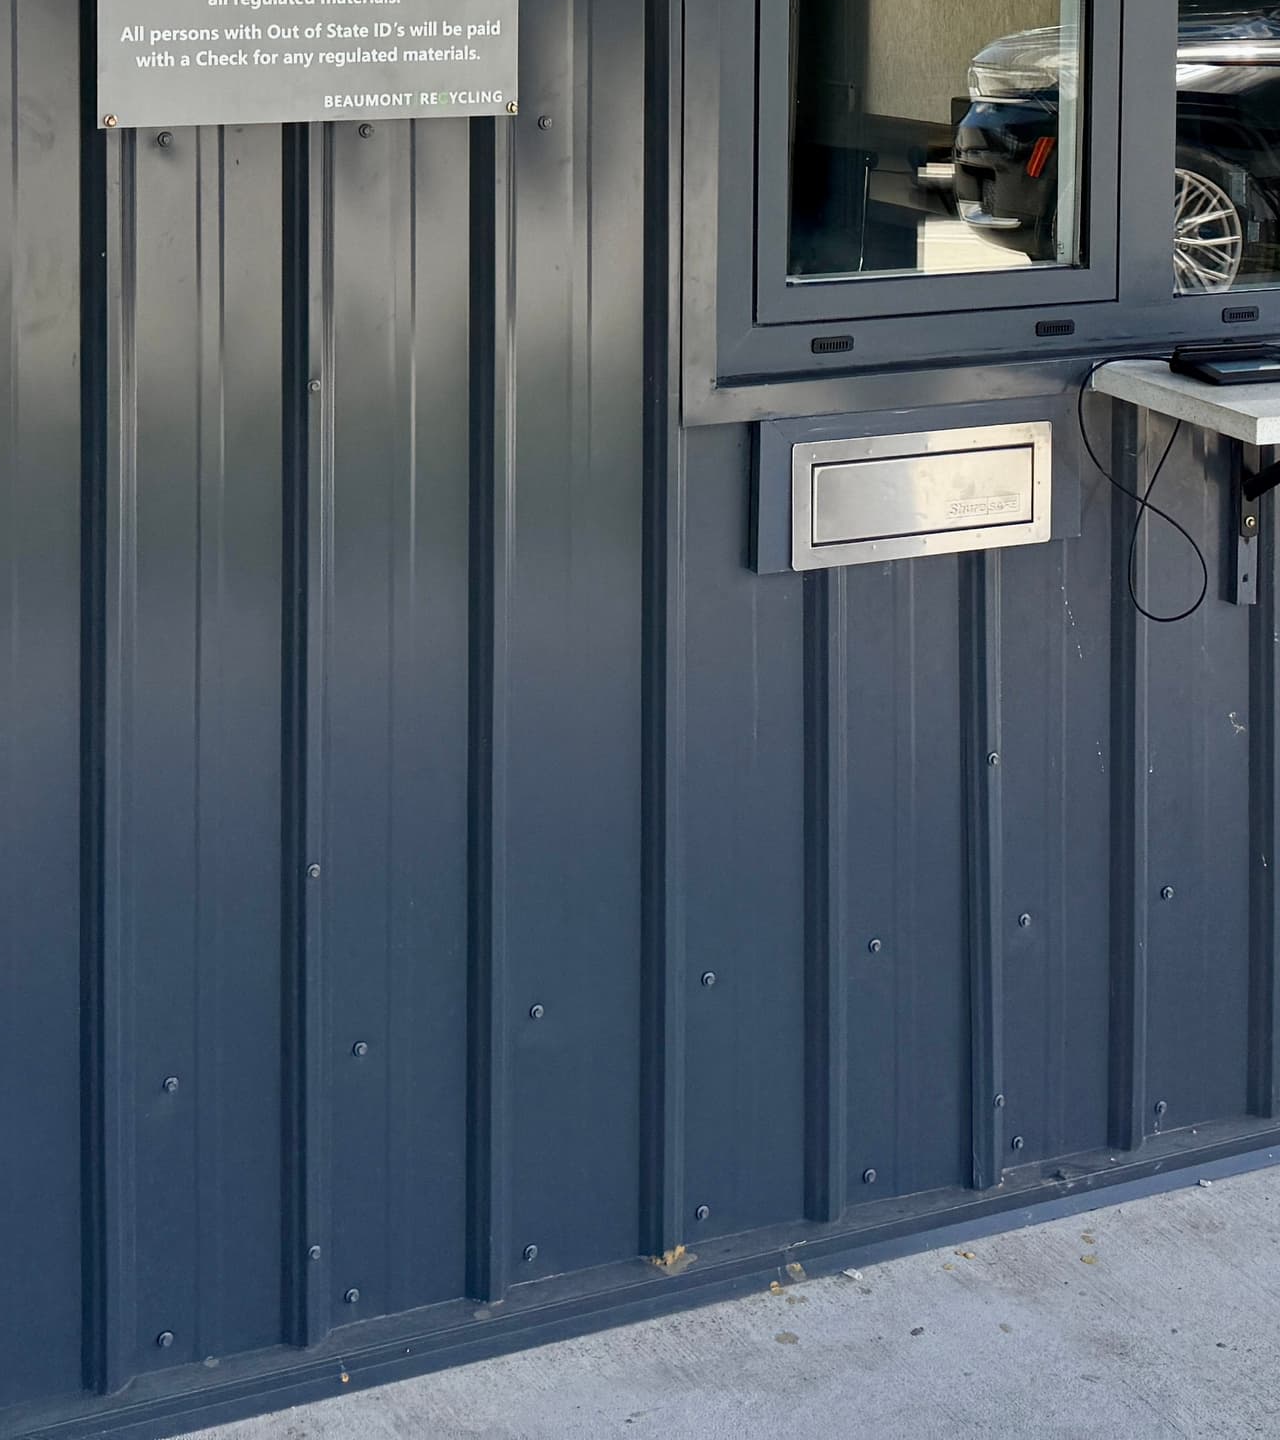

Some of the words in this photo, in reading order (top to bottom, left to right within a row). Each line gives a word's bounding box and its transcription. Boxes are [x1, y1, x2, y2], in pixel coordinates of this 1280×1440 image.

[120, 25, 144, 43] All
[150, 29, 220, 46] persons
[224, 24, 262, 40] with
[267, 24, 299, 39] Out
[304, 22, 322, 39] of
[327, 23, 369, 38] State
[374, 22, 405, 37] ID's
[409, 21, 437, 37] will
[442, 21, 462, 36] be
[467, 20, 501, 40] paid
[136, 51, 175, 68] with
[180, 55, 190, 67] a
[196, 49, 248, 66] Check
[253, 49, 279, 65] for
[283, 52, 314, 68] any
[319, 46, 398, 67] regulated
[403, 45, 481, 62] materials.
[324, 93, 413, 108] BEAUMONT
[420, 90, 502, 105] RECYCLING
